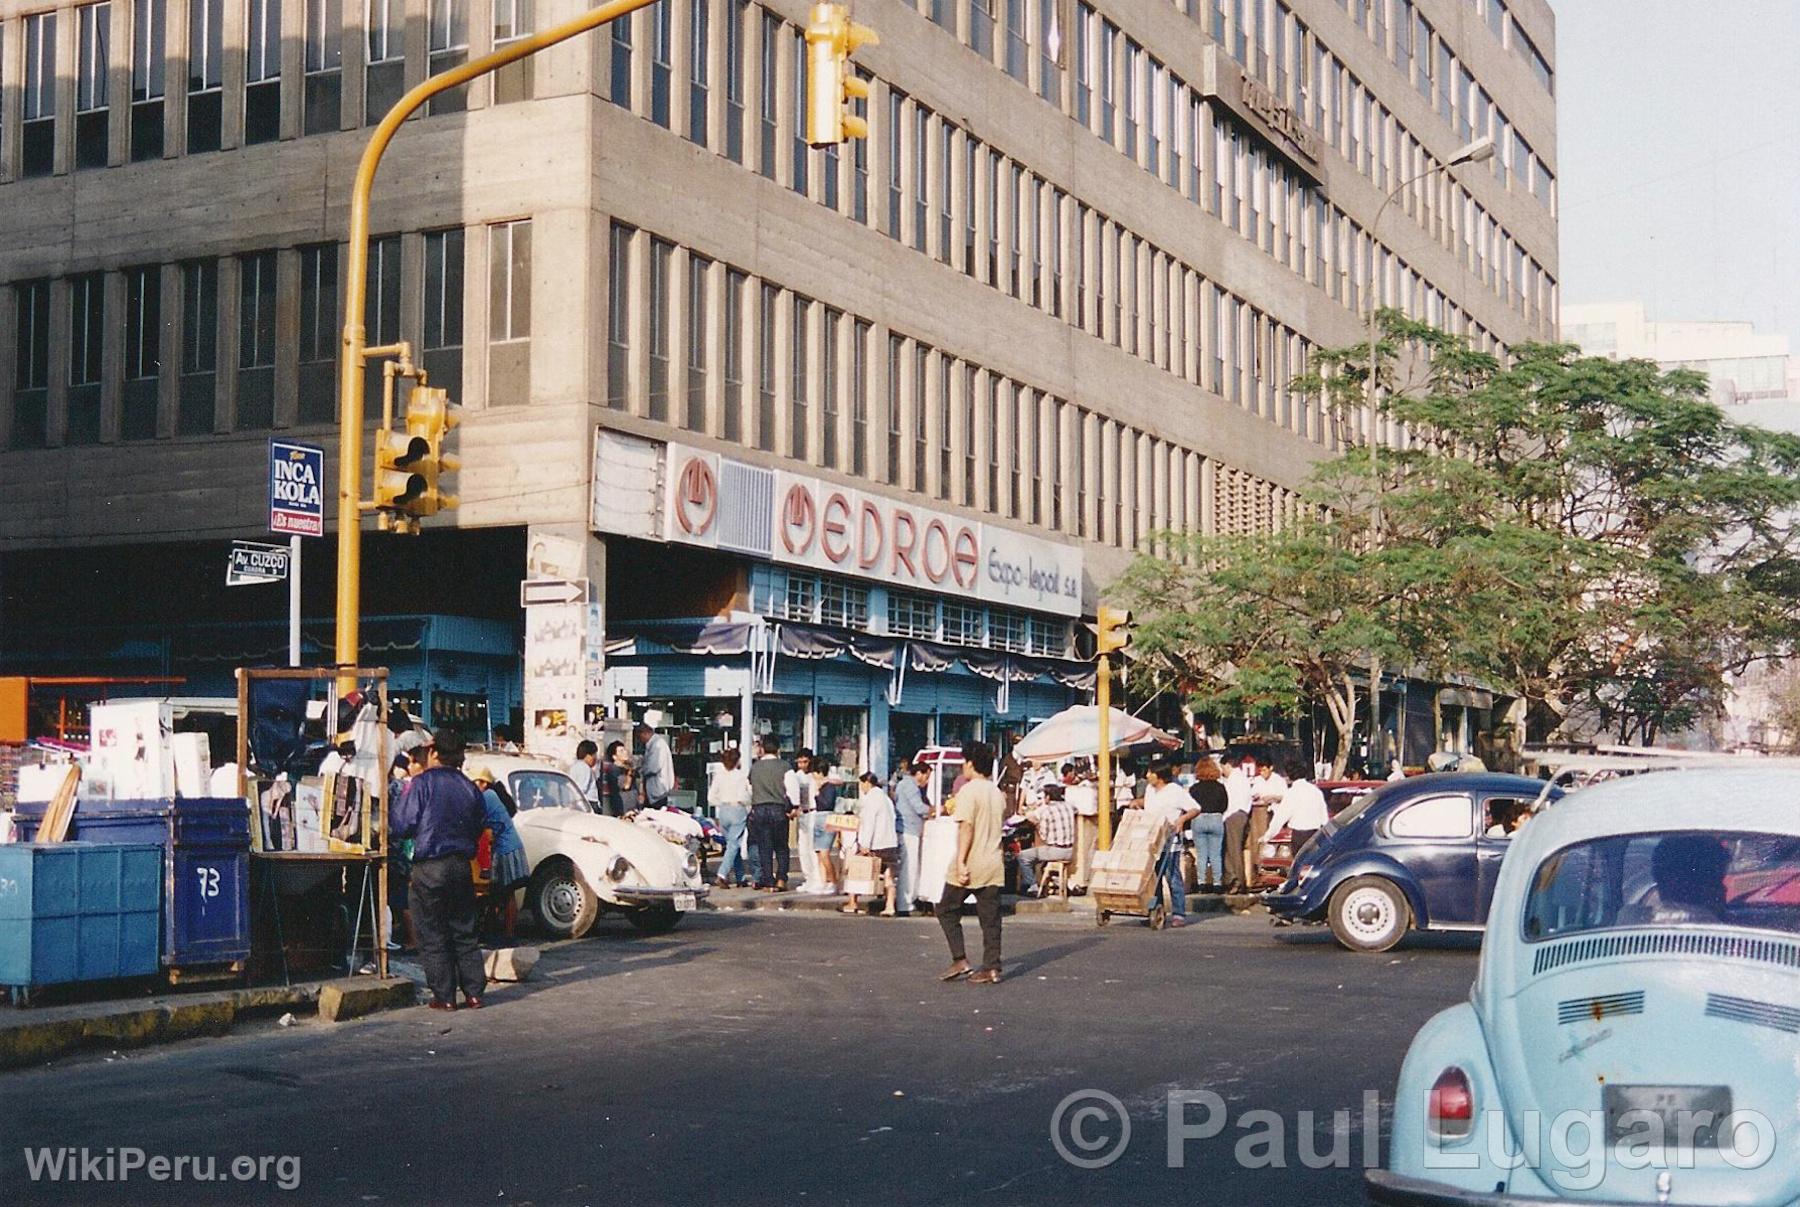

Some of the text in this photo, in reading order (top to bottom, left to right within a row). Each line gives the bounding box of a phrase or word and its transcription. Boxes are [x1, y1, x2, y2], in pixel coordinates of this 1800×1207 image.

[275, 459, 315, 485] INCA
[275, 480, 320, 505] KOLA
[235, 552, 285, 569] Av. CUZCO
[196, 867, 221, 897] 73
